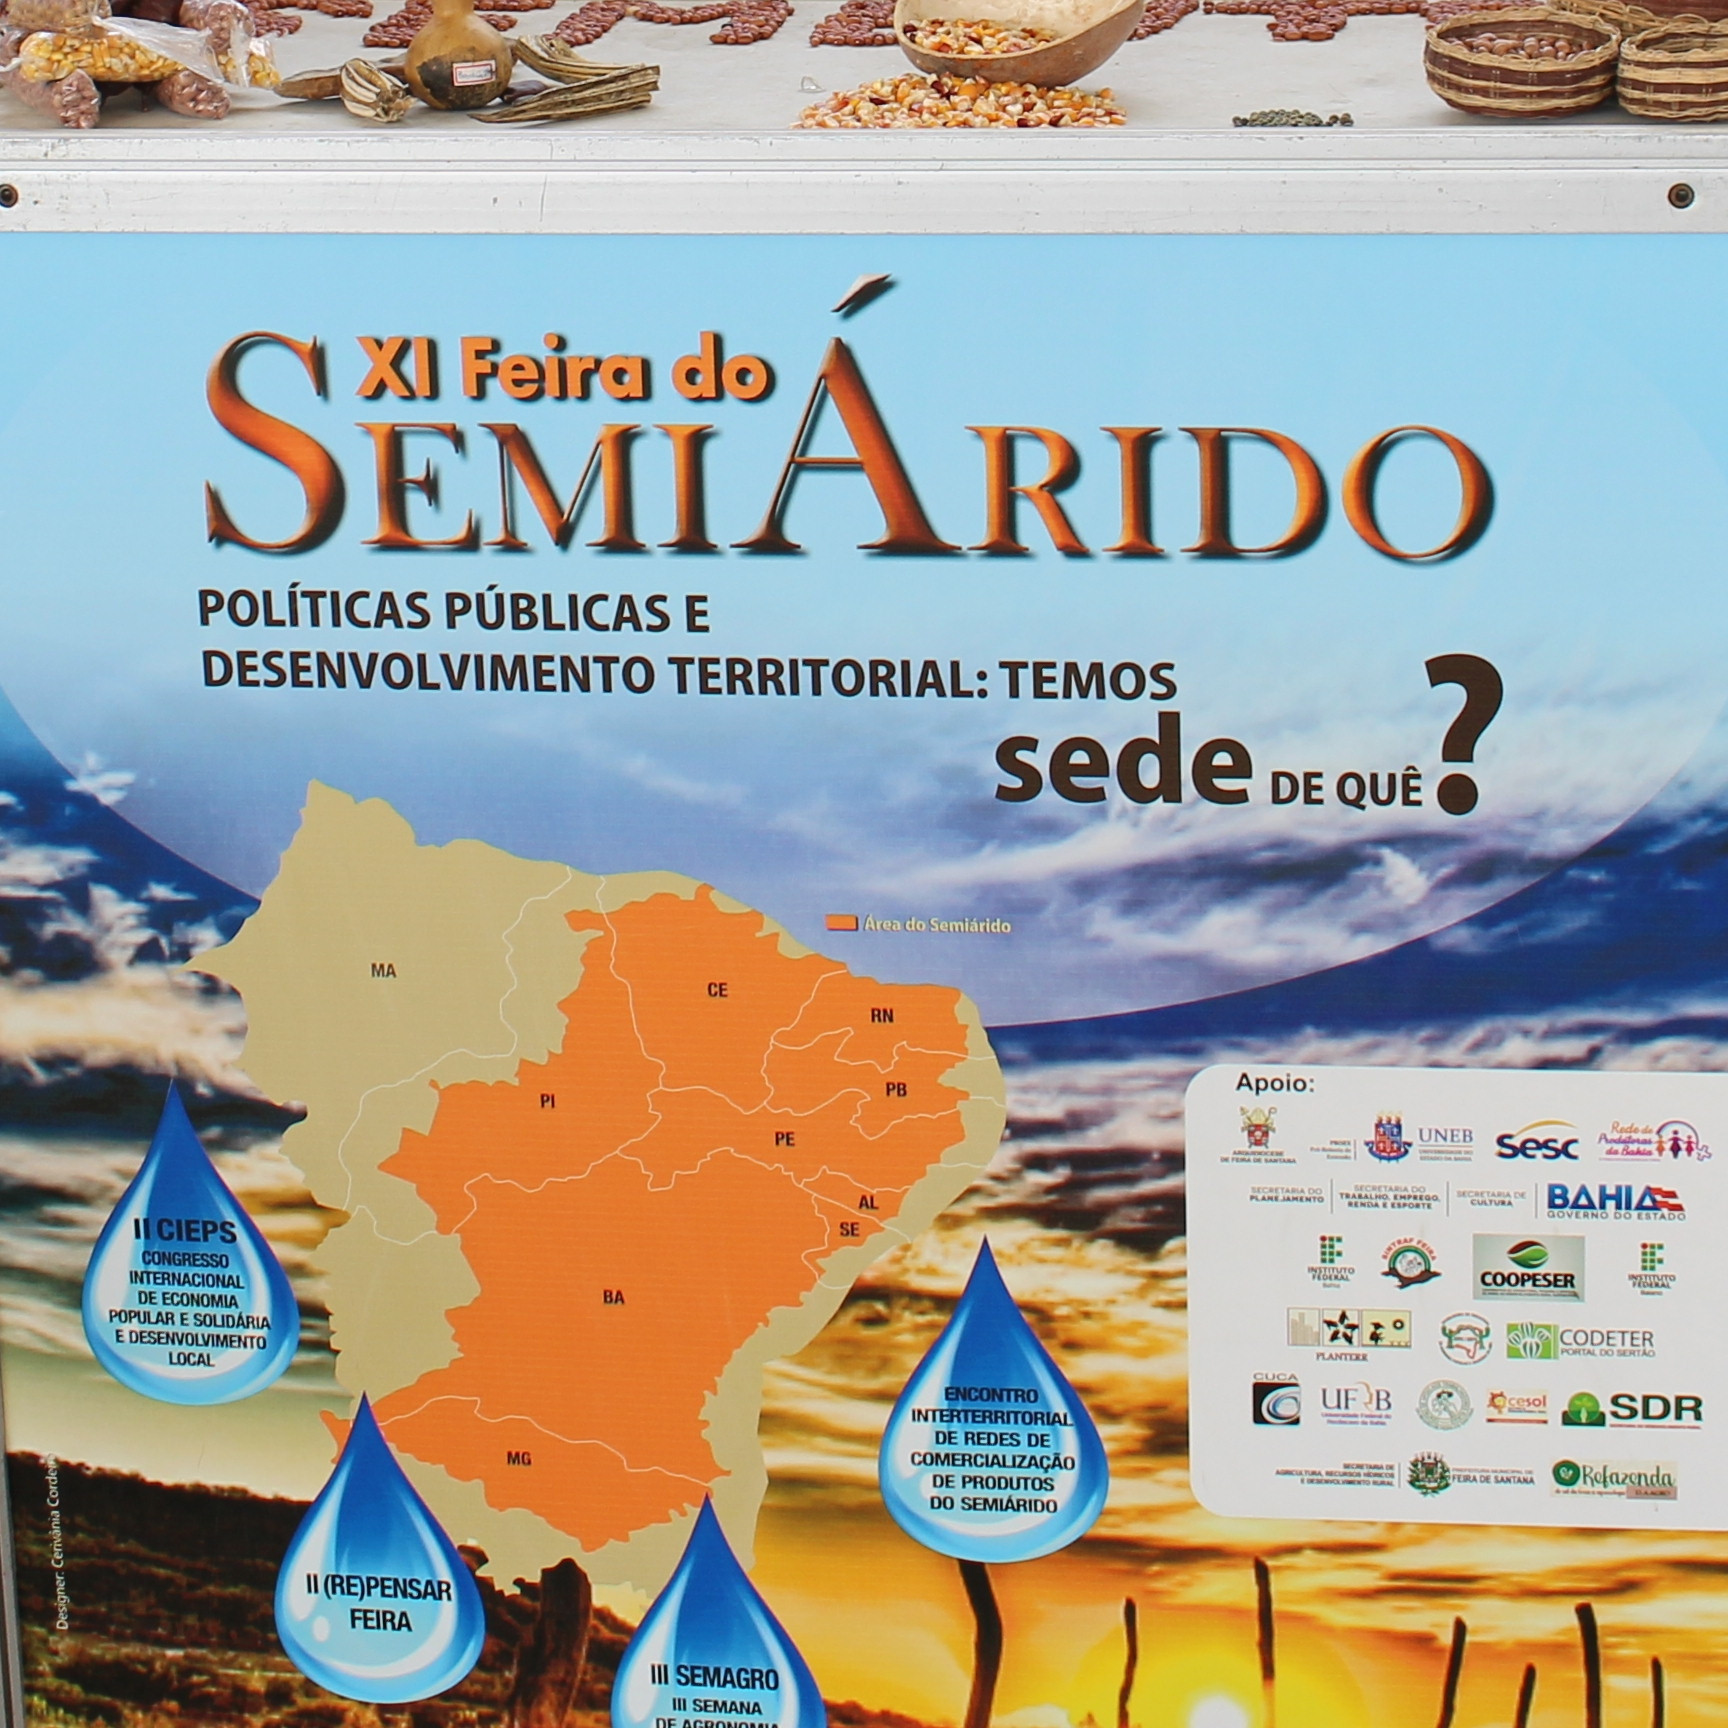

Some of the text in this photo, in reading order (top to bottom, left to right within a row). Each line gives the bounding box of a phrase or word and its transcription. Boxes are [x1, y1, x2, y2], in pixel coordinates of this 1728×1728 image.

[357, 332, 770, 403] XI Feira do
[203, 273, 1498, 564] SEMIÁRIDO
[197, 581, 710, 635] POLÍTICAS PÚBLICAS E
[202, 648, 1178, 702] DESENVOLVIMENTO TERRITORIAL: TEMOS
[994, 711, 1254, 805] sede
[1272, 770, 1325, 806] DE
[864, 914, 1012, 935] Área do Semiárido
[371, 962, 397, 979] MA
[707, 981, 728, 999] CE
[870, 1007, 895, 1024] RN
[885, 1081, 907, 1098] PB
[1236, 1072, 1314, 1096] Apoio:
[539, 1093, 556, 1110] PI
[775, 1131, 796, 1148] PE
[1418, 1127, 1474, 1143] UNEB
[1495, 1133, 1580, 1160] Sesc
[1250, 1186, 1323, 1195] SECRETARIA DO
[1353, 1184, 1426, 1193] SECRETARIA DO
[1456, 1189, 1527, 1199] SECRETARIA DE
[1546, 1183, 1662, 1211] BAHIA
[858, 1194, 879, 1211] AL
[1249, 1195, 1325, 1204] PLANEJAMENTO
[1391, 1201, 1432, 1209] ESPORTE
[1470, 1199, 1514, 1208] CULTURA
[1546, 1210, 1686, 1222] GOVERNO DO ESTADO
[134, 1218, 238, 1244] II CIEPS
[839, 1221, 860, 1238] SE
[142, 1250, 230, 1269] CONGRESSO
[129, 1270, 245, 1289] INTERNACIONAL
[1307, 1266, 1355, 1275] INSTITUTO
[1312, 1273, 1350, 1281] FEDERAL
[1628, 1273, 1676, 1283] INSTITUTO
[1480, 1271, 1576, 1289] COOPESER
[1632, 1281, 1672, 1289] FEDERAL
[138, 1290, 239, 1309] DE ECONOMIA
[603, 1288, 625, 1306] BA
[109, 1309, 272, 1330] POPULAR E SOLIDÁRIA
[115, 1329, 267, 1350] E DESENVOLVIMENTO
[1559, 1328, 1654, 1348] CODETER
[169, 1351, 215, 1367] LOCAL
[1560, 1347, 1656, 1358] PORTAL DO SERTÃO
[1253, 1372, 1298, 1381] CUCA
[944, 1386, 1039, 1404] ENCONTRO
[1508, 1394, 1547, 1407] cesol
[1610, 1393, 1703, 1421] SDR
[911, 1408, 1074, 1427] INTERTERRITORIAL
[935, 1430, 1051, 1448] DE REDES DE
[506, 1449, 532, 1467] MG
[911, 1451, 1076, 1473] COMERCIALIZAÇÃO
[932, 1474, 1055, 1492] DE PRODUTOS
[1452, 1474, 1535, 1485] FEIRA DE SANTANA
[1582, 1464, 1676, 1489] Refazenda
[930, 1495, 1058, 1514] DO SEMIÁRIDO
[48, 1509, 64, 1568] Cerivânia
[307, 1573, 453, 1602] II (RE)PENSAR
[54, 1572, 71, 1630] Designer:
[350, 1608, 413, 1633] FEIRA
[650, 1663, 780, 1691] III SEMAGRO
[672, 1697, 763, 1715] III SEMANA
